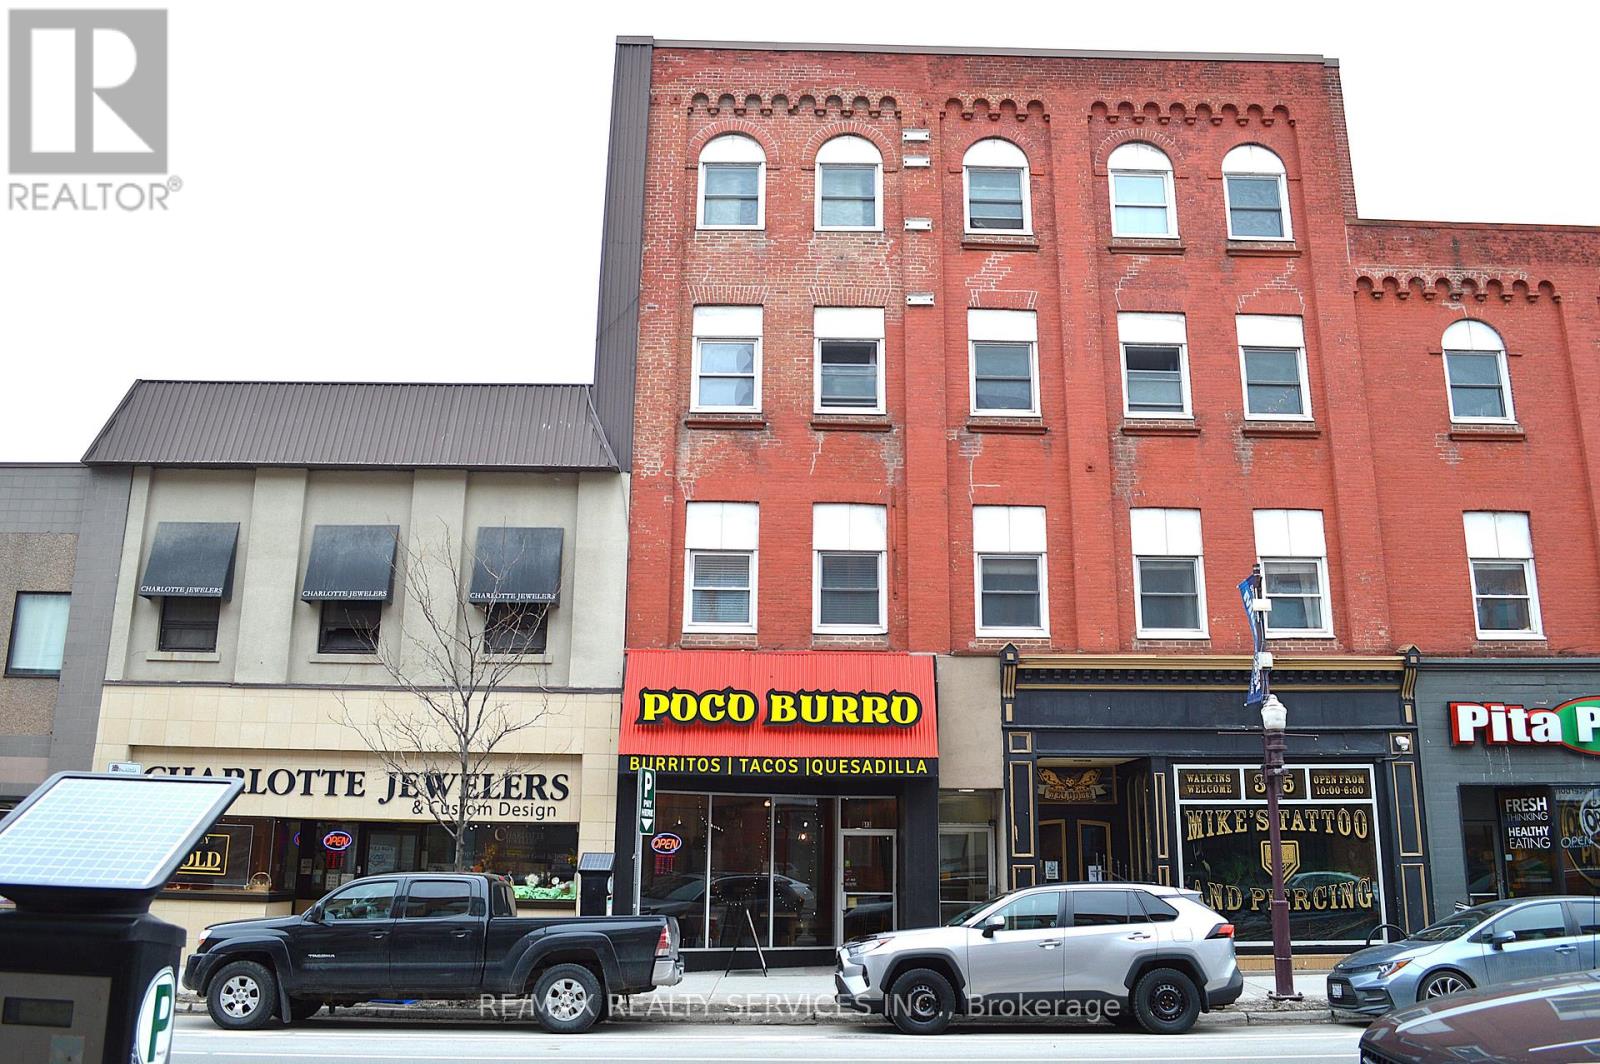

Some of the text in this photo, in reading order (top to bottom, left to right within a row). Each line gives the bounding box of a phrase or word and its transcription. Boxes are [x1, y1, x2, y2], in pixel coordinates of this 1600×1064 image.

[140, 585, 223, 595] CHARLOTTE JEWELERS
[348, 590, 387, 598] JEWELERS
[516, 592, 556, 600] JEWELERS
[639, 688, 921, 727] POCO BURRO
[1454, 704, 1563, 743] Pita
[630, 756, 721, 773] BURRITOS
[739, 757, 799, 774] TACOS
[644, 771, 653, 797] P
[1253, 774, 1294, 793] 35
[1313, 774, 1365, 784] OPEN FROM
[1186, 785, 1232, 794] WELCOME
[412, 802, 423, 815] &
[500, 802, 557, 820] Design
[1505, 797, 1548, 812] FRESH
[1506, 811, 1548, 821] THINKING
[1185, 807, 1368, 841] MIKE'S TATTOO
[1508, 826, 1549, 836] HEALTHY
[327, 835, 350, 847] OPEN
[654, 838, 678, 850] OPEN
[1509, 836, 1551, 849] EATING
[147, 983, 173, 1063] P
